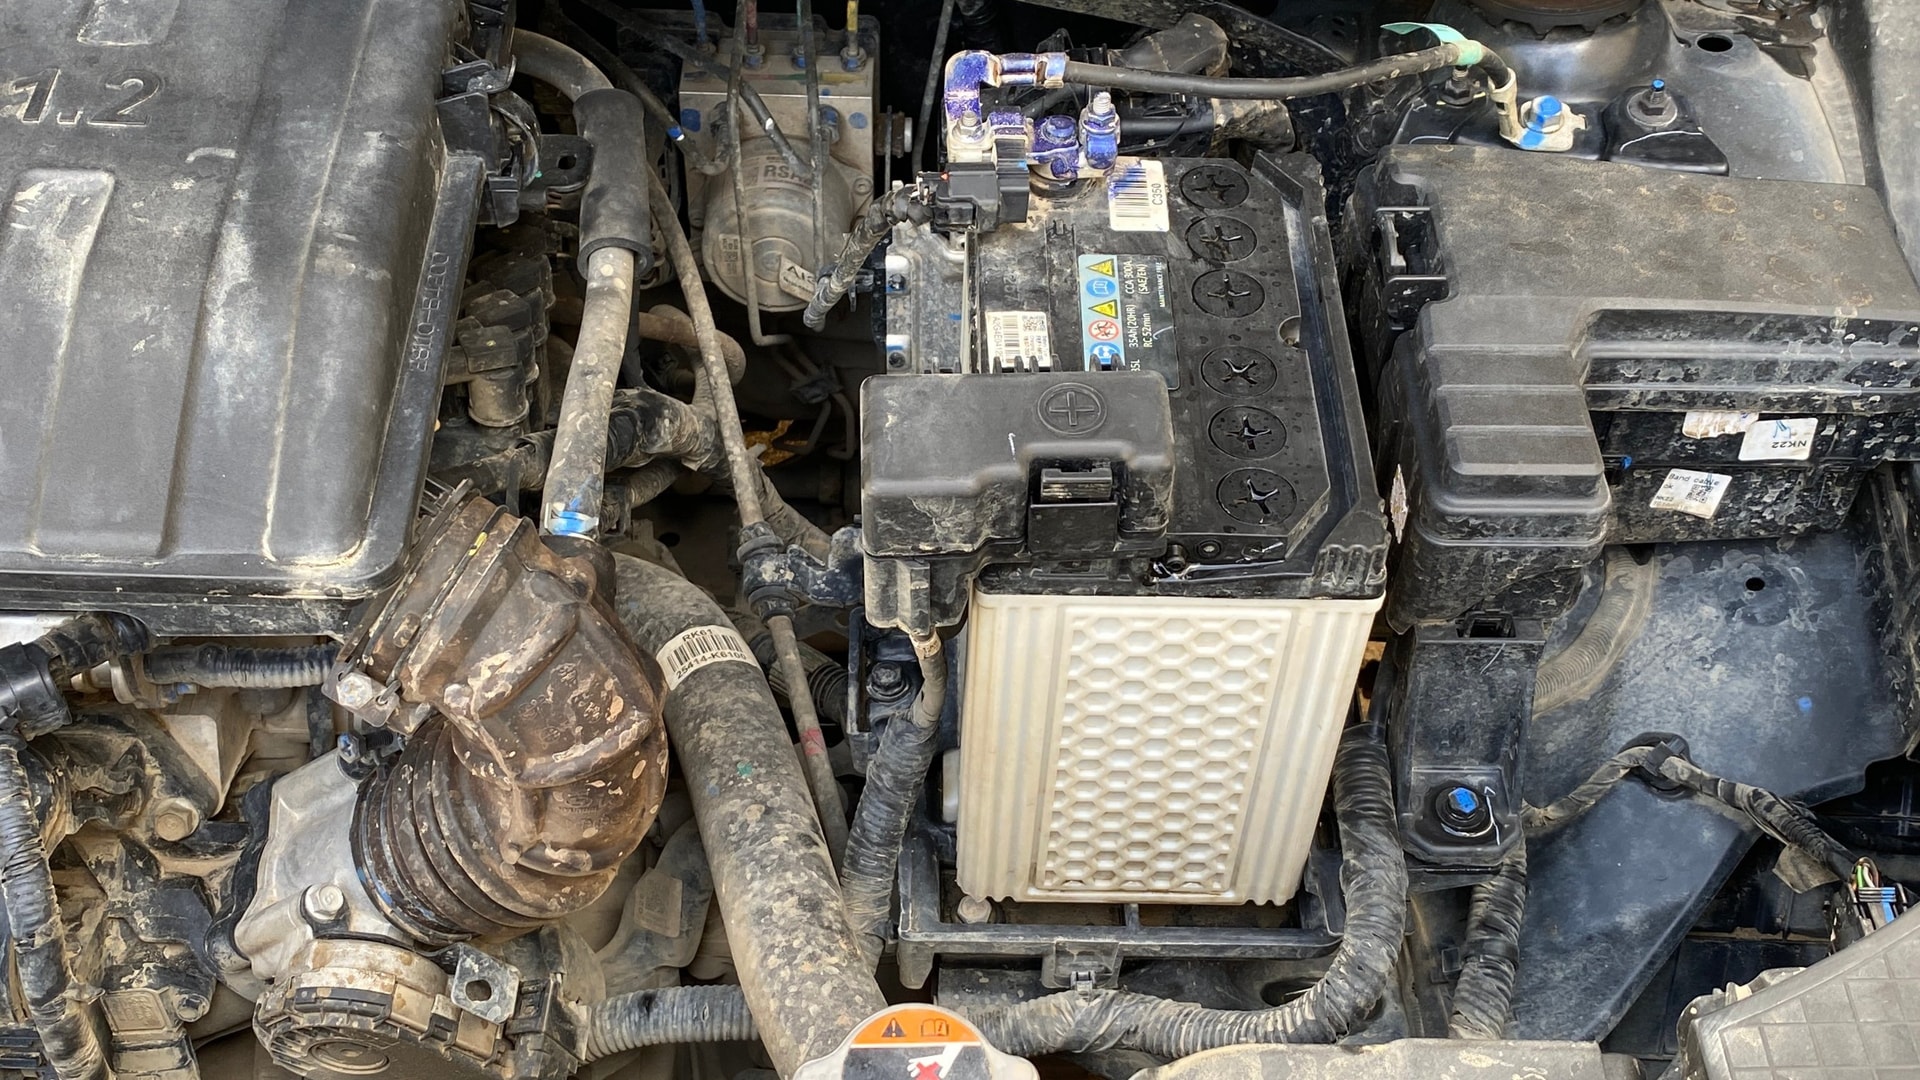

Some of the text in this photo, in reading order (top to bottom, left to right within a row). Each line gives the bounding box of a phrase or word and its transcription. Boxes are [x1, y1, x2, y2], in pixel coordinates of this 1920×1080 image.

[11, 67, 164, 127] 1.2
[1151, 182, 1164, 206] C350
[1124, 279, 1135, 295] CCA
[1136, 263, 1151, 295] (SAE/EN)
[1125, 303, 1140, 348] 35Ah(20HR)
[1141, 312, 1153, 348] RC 52min
[1771, 439, 1807, 449] NK22
[1668, 473, 1691, 482] Band
[682, 628, 713, 642] RK61
[675, 650, 747, 679] 25414-K6100
